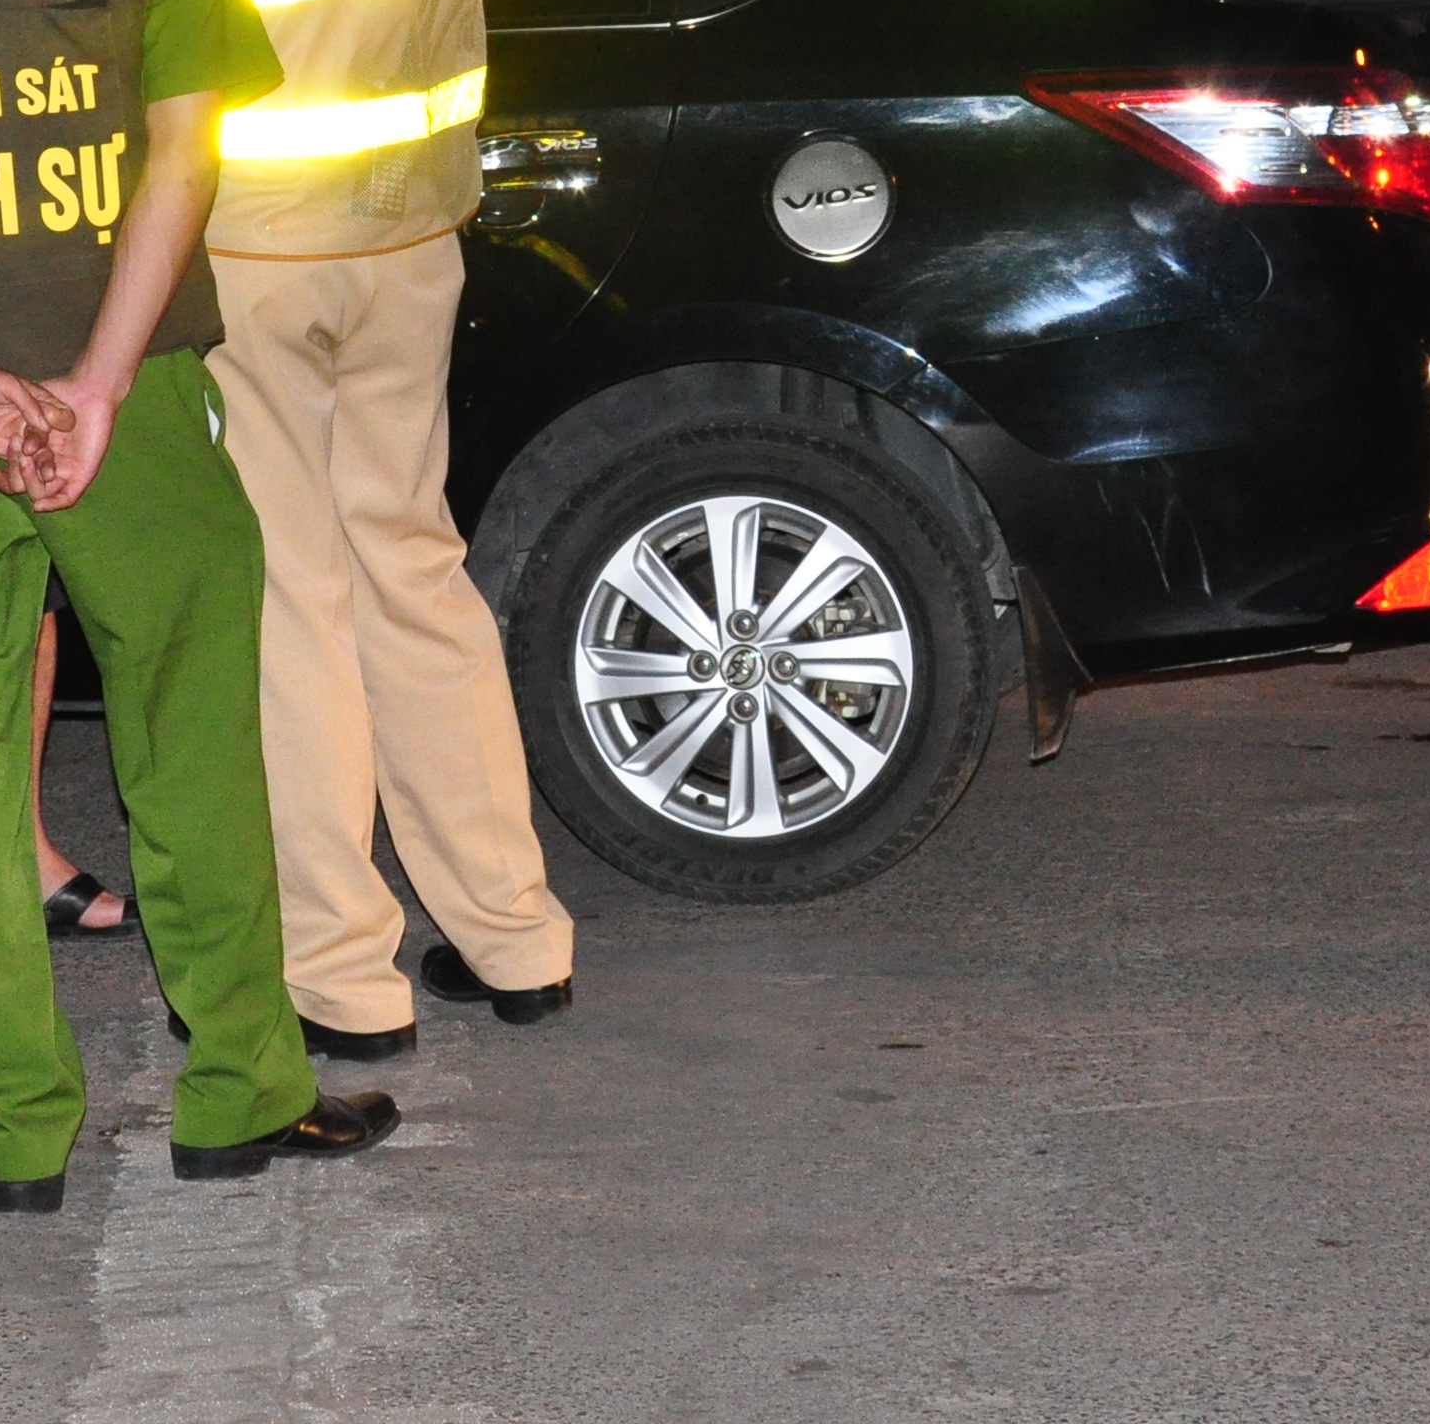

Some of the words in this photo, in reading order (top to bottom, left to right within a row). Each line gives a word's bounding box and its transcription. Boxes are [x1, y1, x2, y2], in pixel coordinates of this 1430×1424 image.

[15, 55, 99, 117] SÁT
[37, 131, 127, 246] SỰ
[780, 182, 878, 212] VIOS
